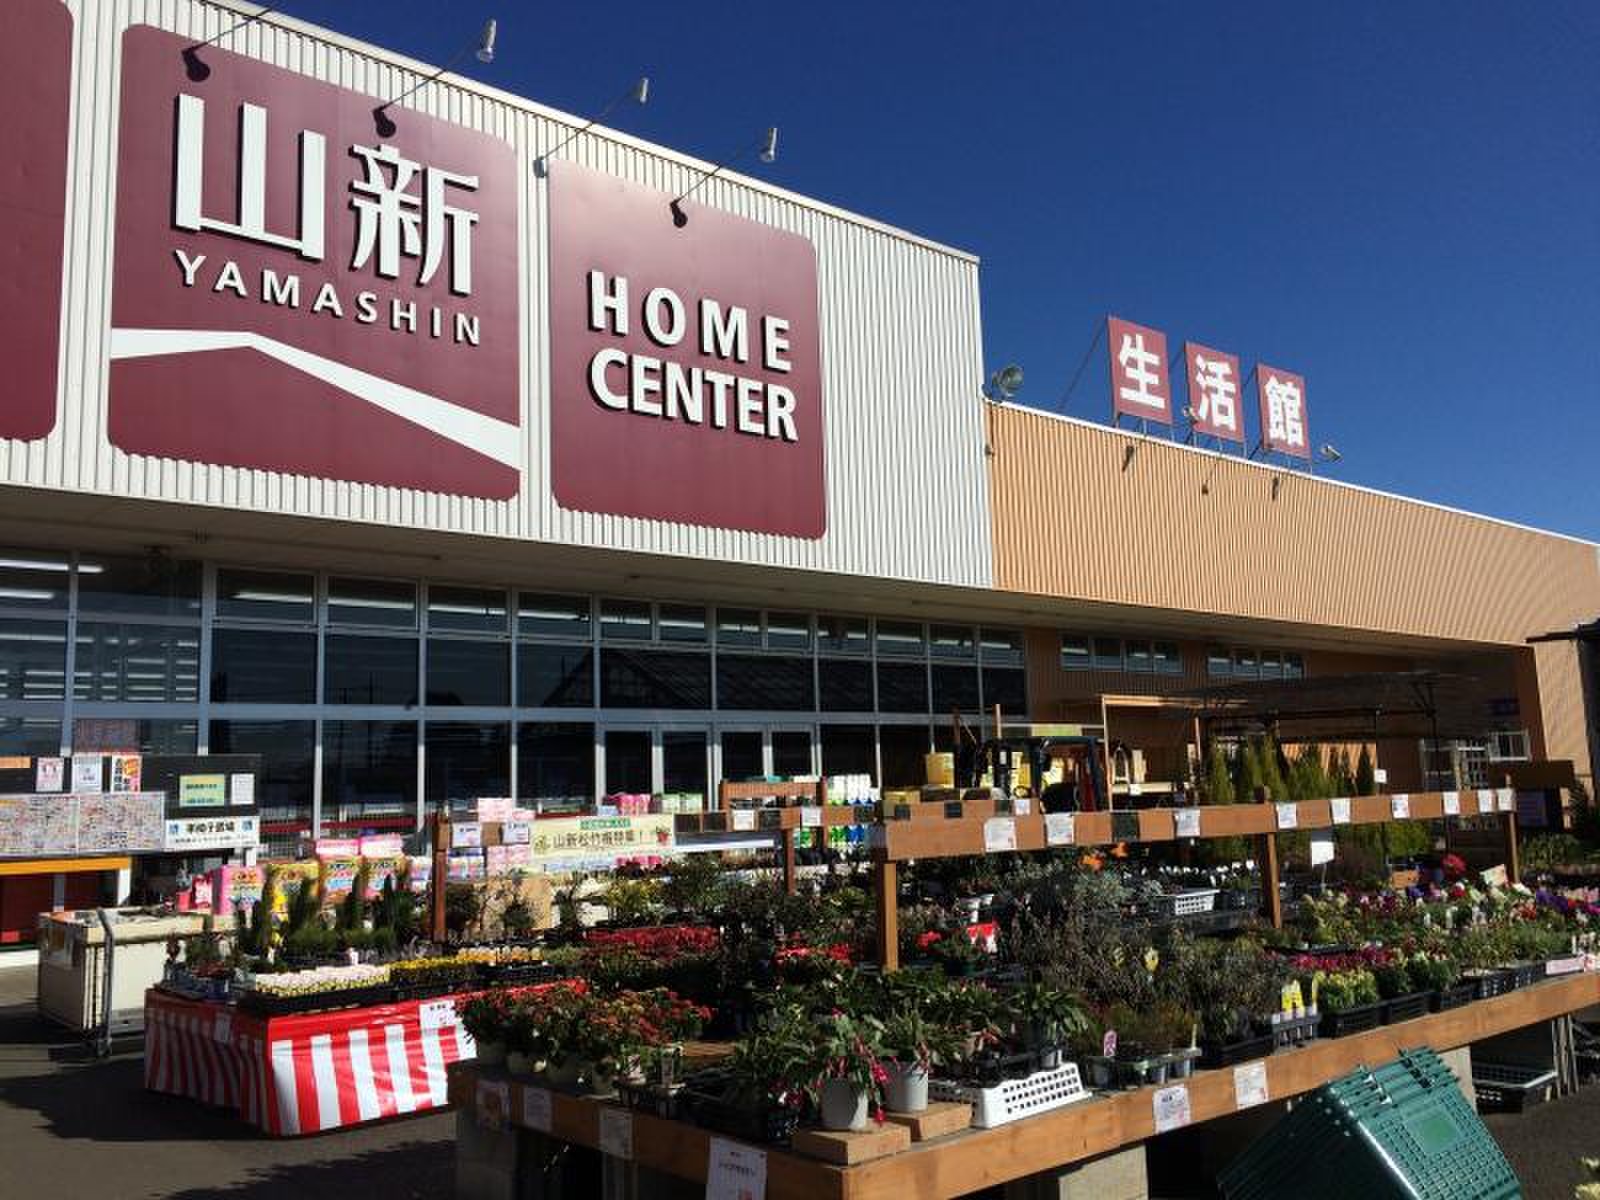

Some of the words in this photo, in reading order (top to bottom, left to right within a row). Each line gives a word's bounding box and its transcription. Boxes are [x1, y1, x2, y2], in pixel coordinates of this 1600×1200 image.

[174, 93, 479, 295] 山新
[174, 249, 480, 346] YAMASHIN
[588, 268, 792, 374] HOME
[589, 347, 799, 442] CENTER
[1119, 333, 1304, 446] 生活館
